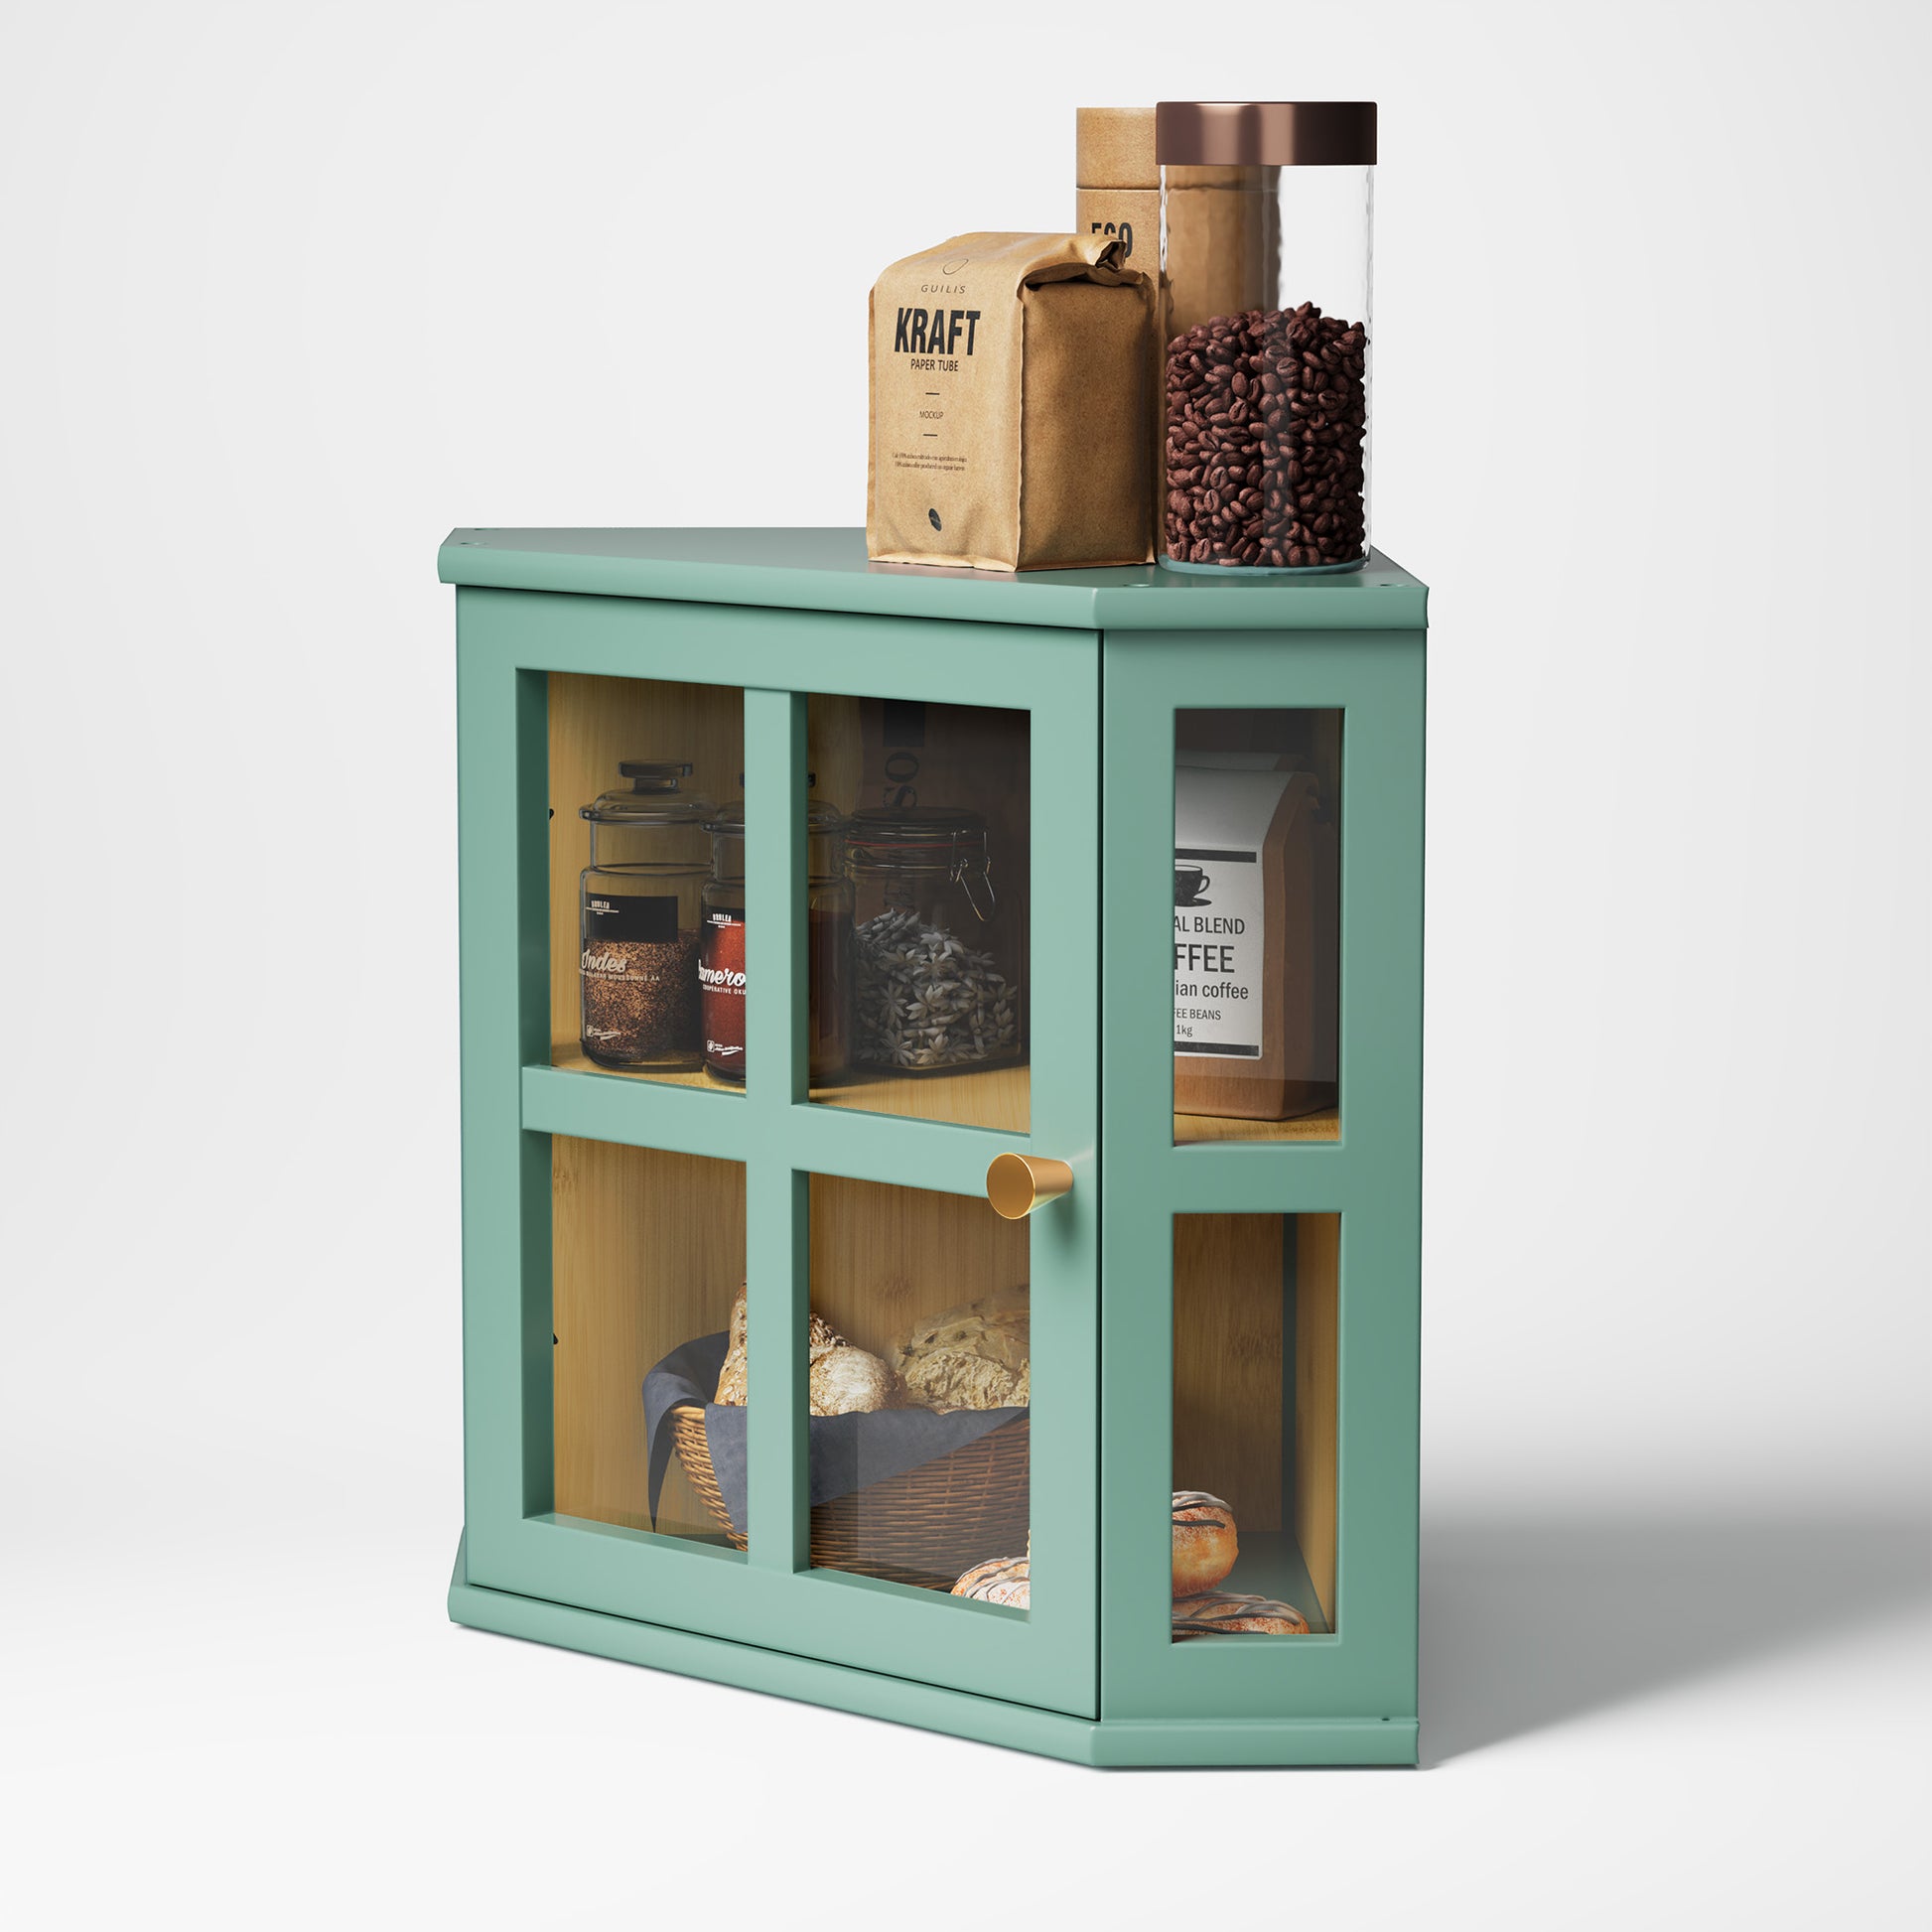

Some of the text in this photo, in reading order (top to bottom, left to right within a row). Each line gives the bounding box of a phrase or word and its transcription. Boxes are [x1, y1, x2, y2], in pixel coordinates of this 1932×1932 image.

[920, 284, 966, 294] GUILIS
[895, 307, 981, 355] KRAFT
[910, 357, 959, 371] PAPER TUBE
[919, 410, 944, 419] MOCKUP
[1194, 916, 1245, 934] BLEND
[581, 949, 626, 973] Indes
[1175, 980, 1249, 1000] ian coffee
[1189, 1009, 1222, 1021] BEANS
[1176, 1025, 1193, 1037] 1kg
